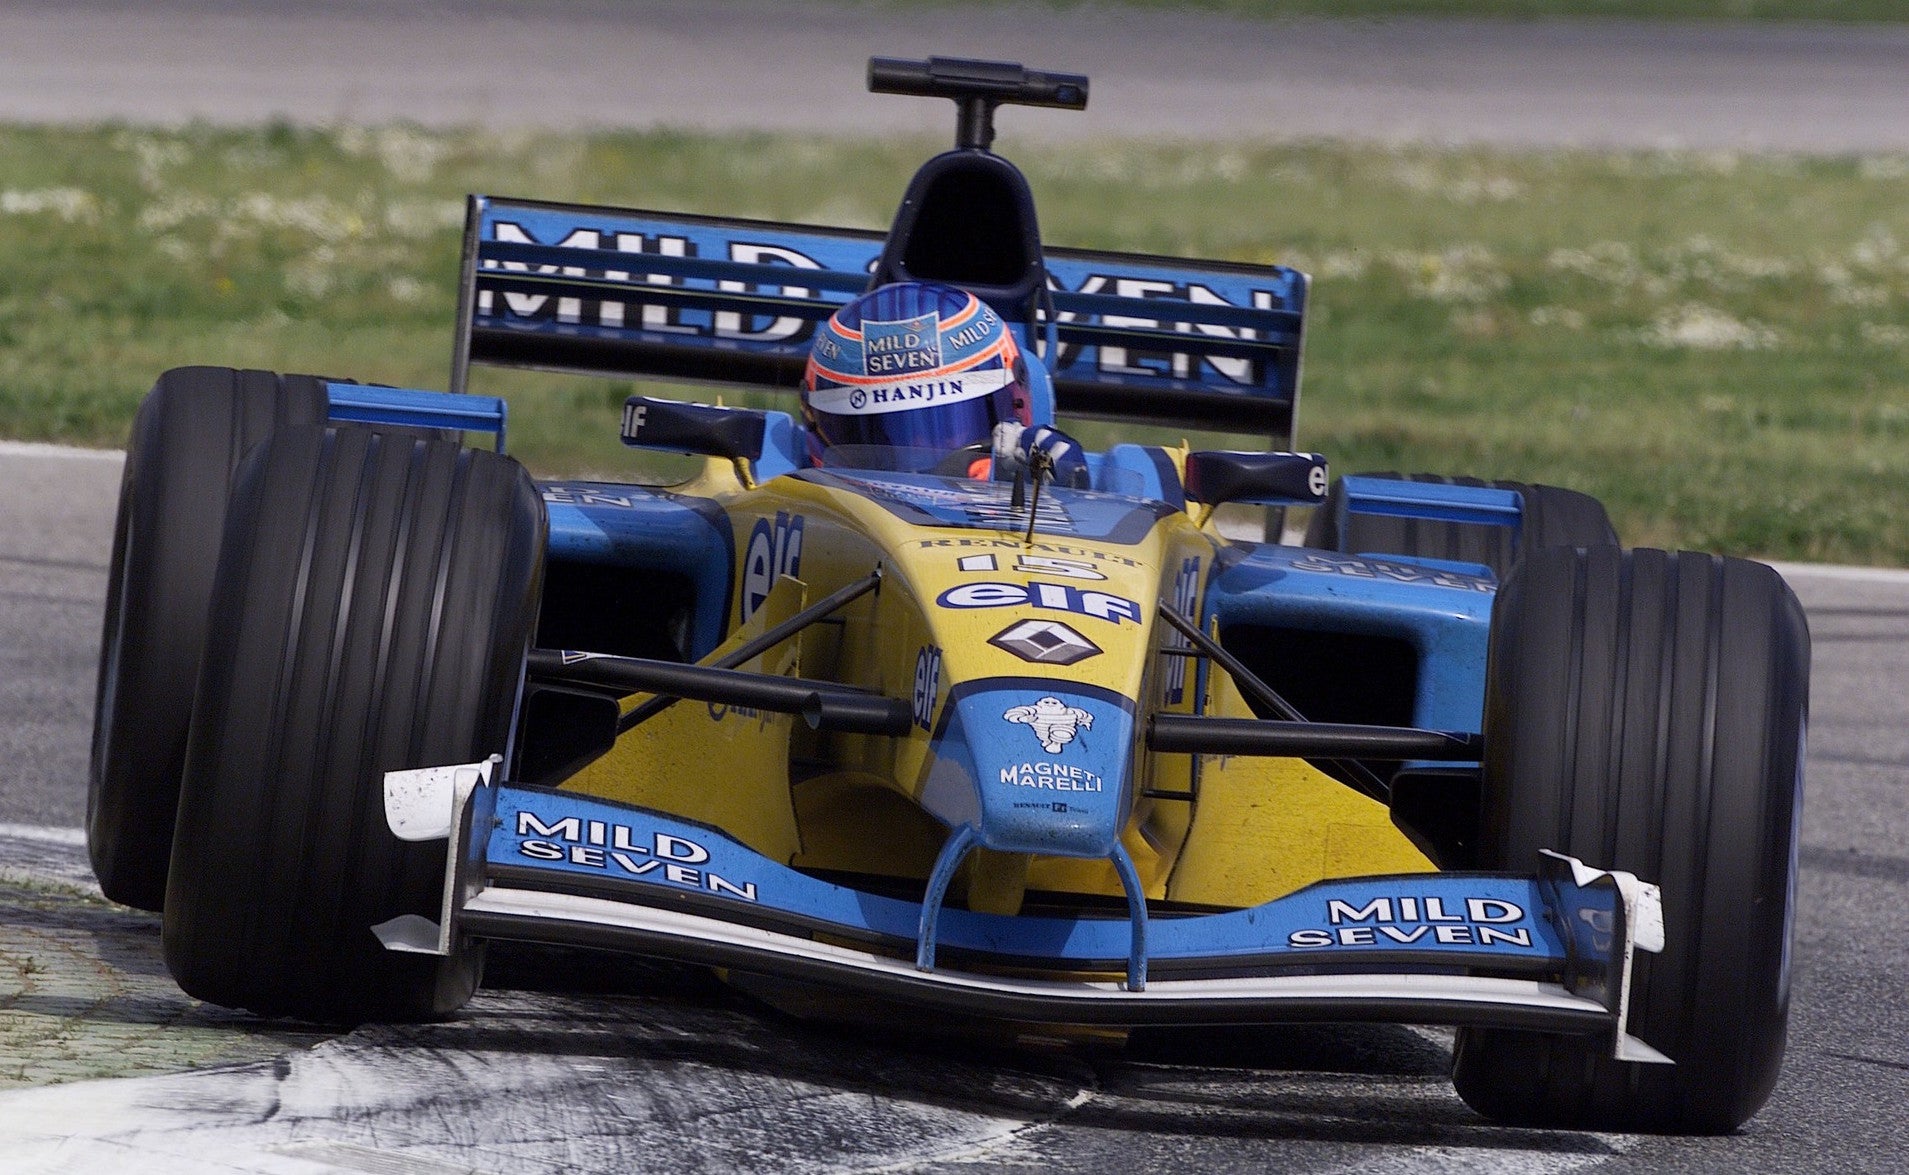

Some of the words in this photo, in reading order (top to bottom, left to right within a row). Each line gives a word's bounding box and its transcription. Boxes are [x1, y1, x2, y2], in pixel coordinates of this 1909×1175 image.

[477, 222, 825, 342] MILD
[868, 333, 920, 352] MILD
[948, 320, 991, 350] MILD
[869, 351, 936, 373] SEVEN
[873, 380, 964, 404] HANJIN
[920, 539, 1143, 567] RENAULT
[957, 553, 1109, 581] 15
[936, 581, 1142, 625] elf
[1000, 765, 1102, 792] MARELLI
[516, 811, 711, 864] MILD
[519, 839, 758, 901] SEVEN
[1328, 897, 1525, 926] MILD
[1288, 925, 1534, 948] SEVEN
